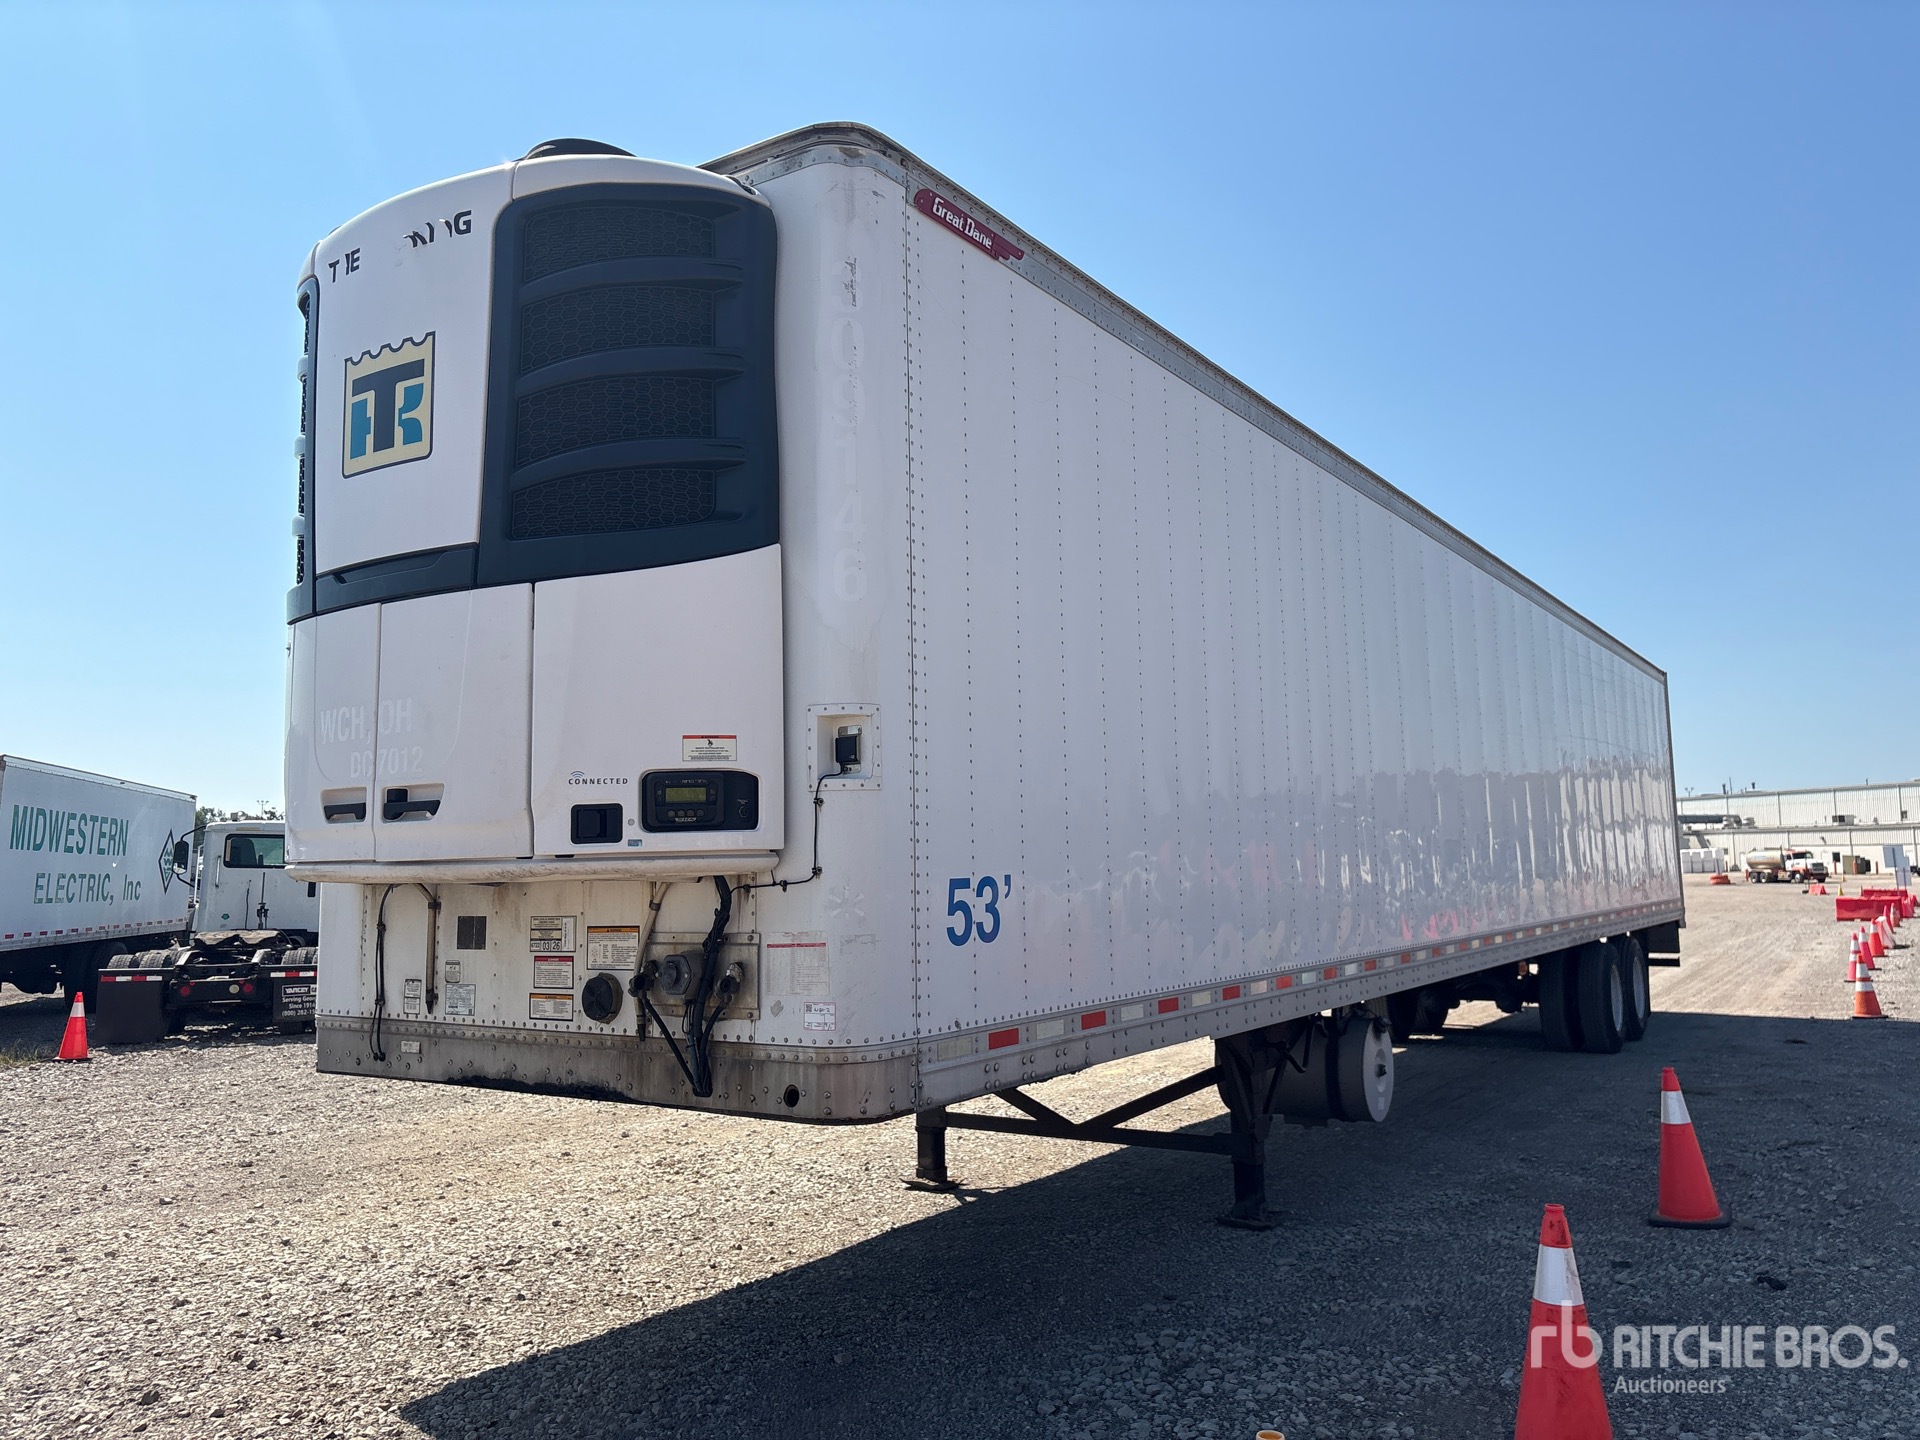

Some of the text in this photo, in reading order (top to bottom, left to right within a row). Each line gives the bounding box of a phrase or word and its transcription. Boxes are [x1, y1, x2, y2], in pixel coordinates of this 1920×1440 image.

[932, 197, 992, 250] Great Dane
[568, 777, 628, 785] CONNECTED
[9, 804, 129, 857] MIDWESTERN
[33, 872, 142, 906] ELECTRIC, Inc
